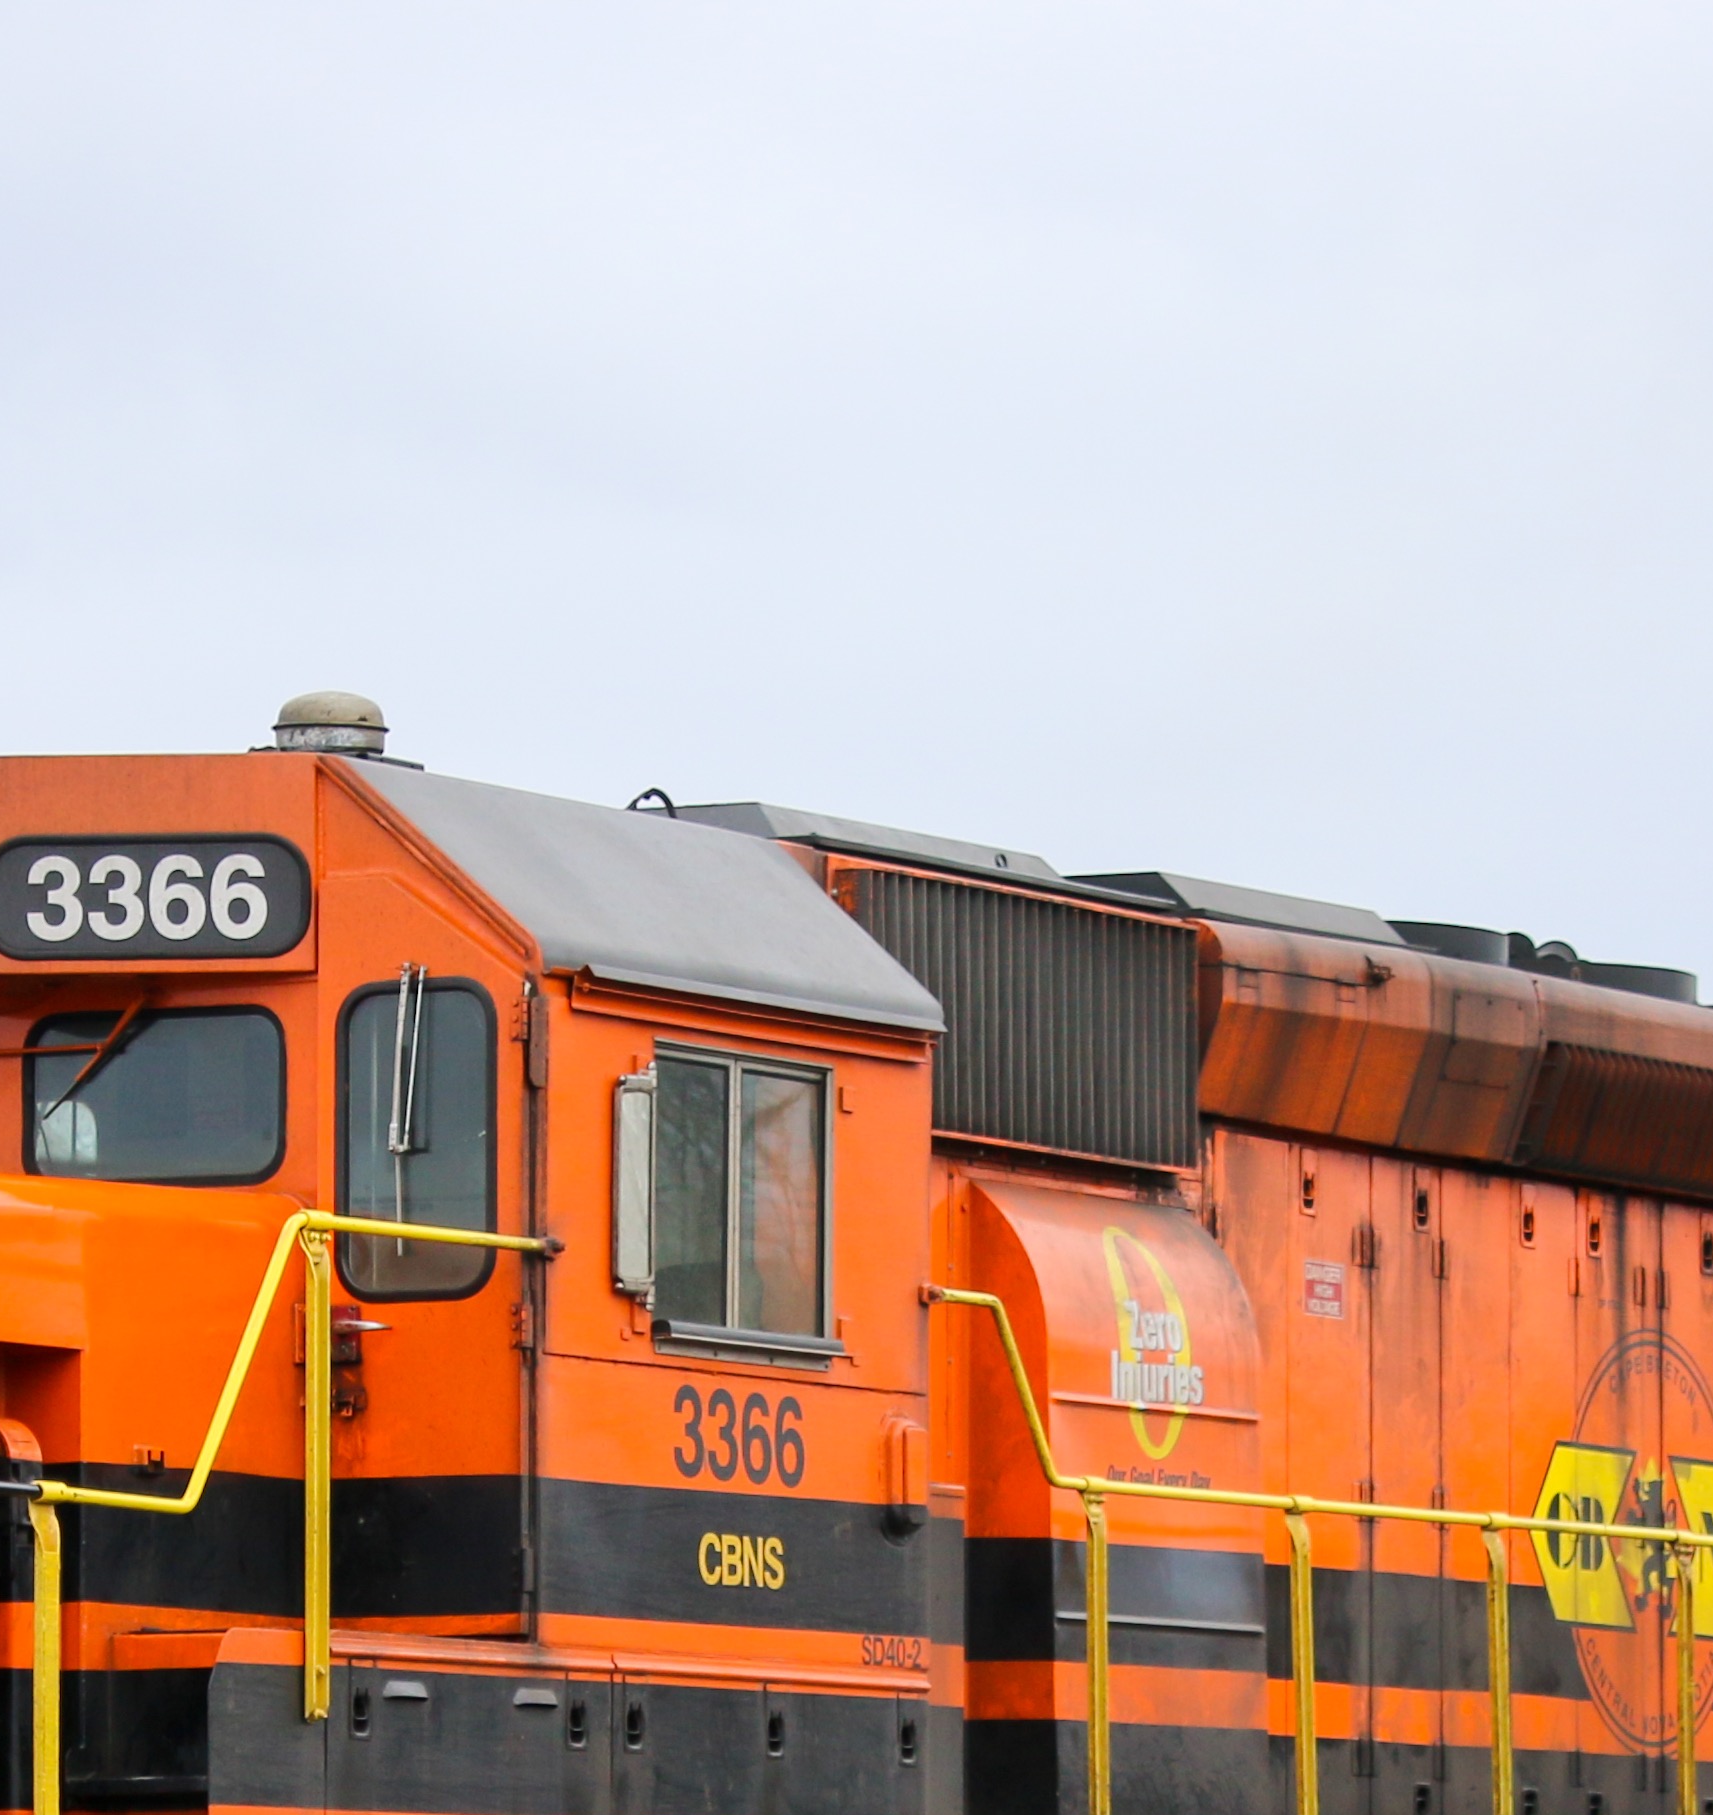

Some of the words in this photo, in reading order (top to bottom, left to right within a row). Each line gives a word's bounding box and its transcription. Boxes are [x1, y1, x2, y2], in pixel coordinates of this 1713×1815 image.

[26, 853, 269, 943] 3366
[1124, 1299, 1183, 1352] Zero
[1111, 1349, 1205, 1410] Injuries
[673, 1384, 806, 1489] 3366
[697, 1532, 786, 1590] CBNS
[861, 1635, 923, 1669] SD40-2
[1585, 1637, 1636, 1728] CENTRAL
